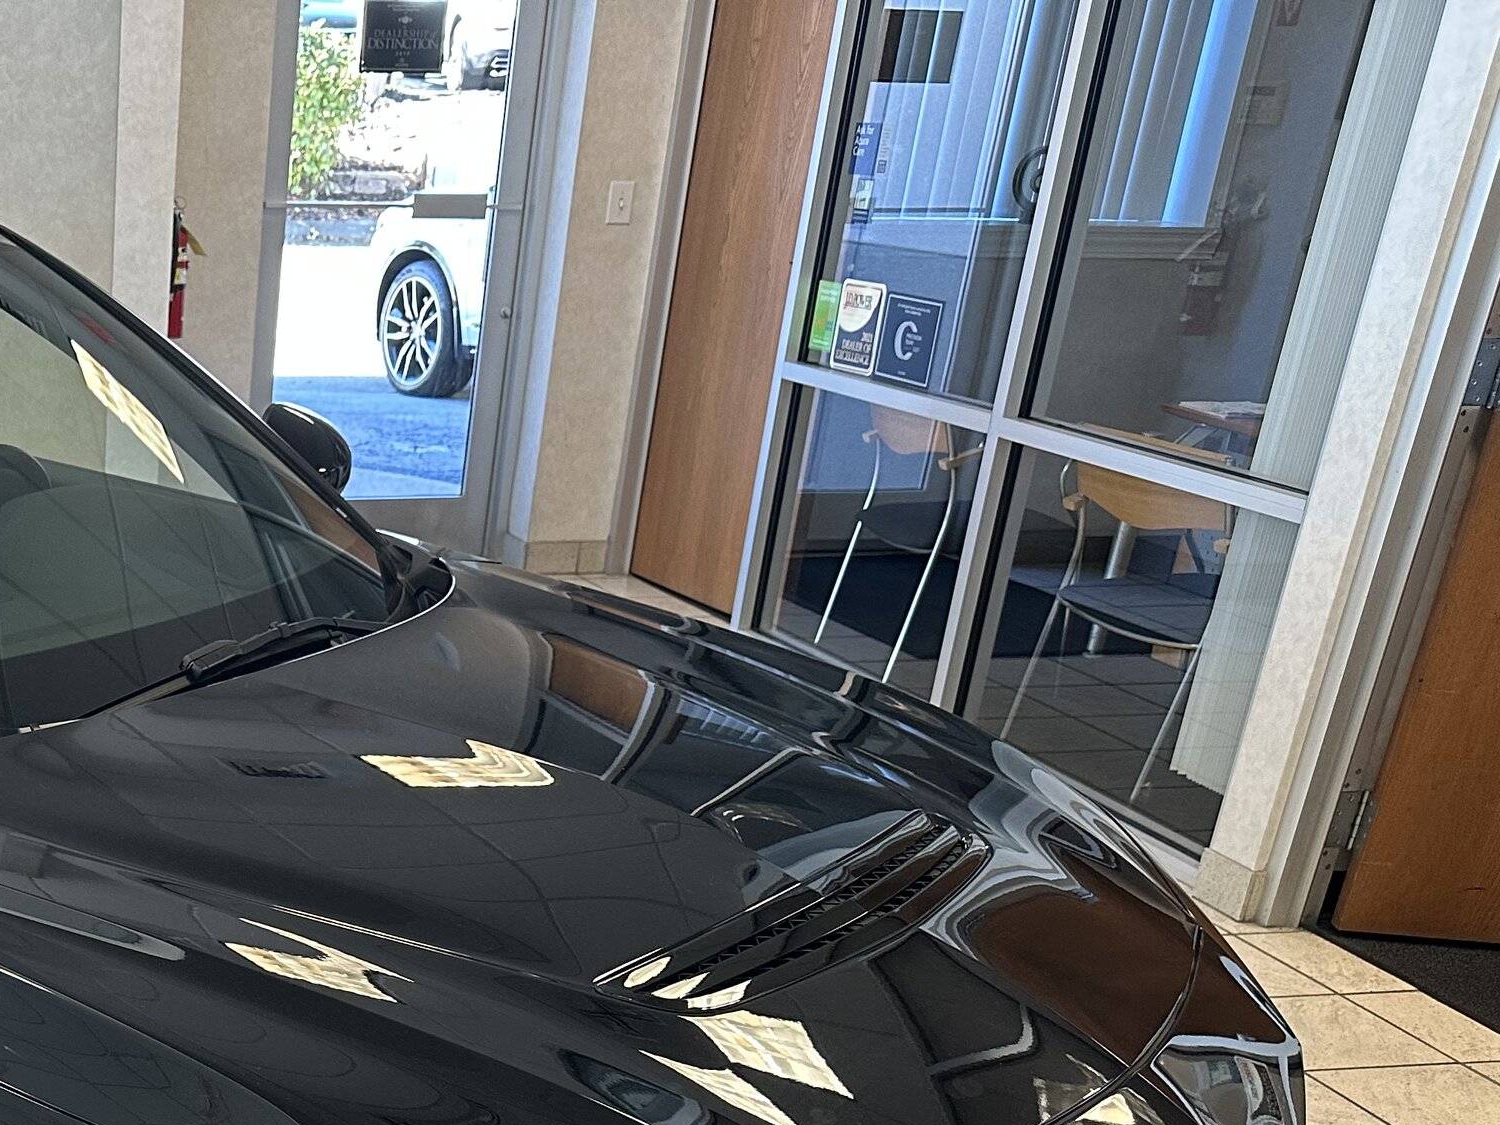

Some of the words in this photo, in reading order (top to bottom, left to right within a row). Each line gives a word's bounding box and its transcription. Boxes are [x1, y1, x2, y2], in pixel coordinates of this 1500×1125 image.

[367, 37, 440, 50] DISTINCTION
[841, 338, 864, 351] DEALER
[863, 342, 872, 353] OF
[835, 348, 871, 366] EXCELLENCE
